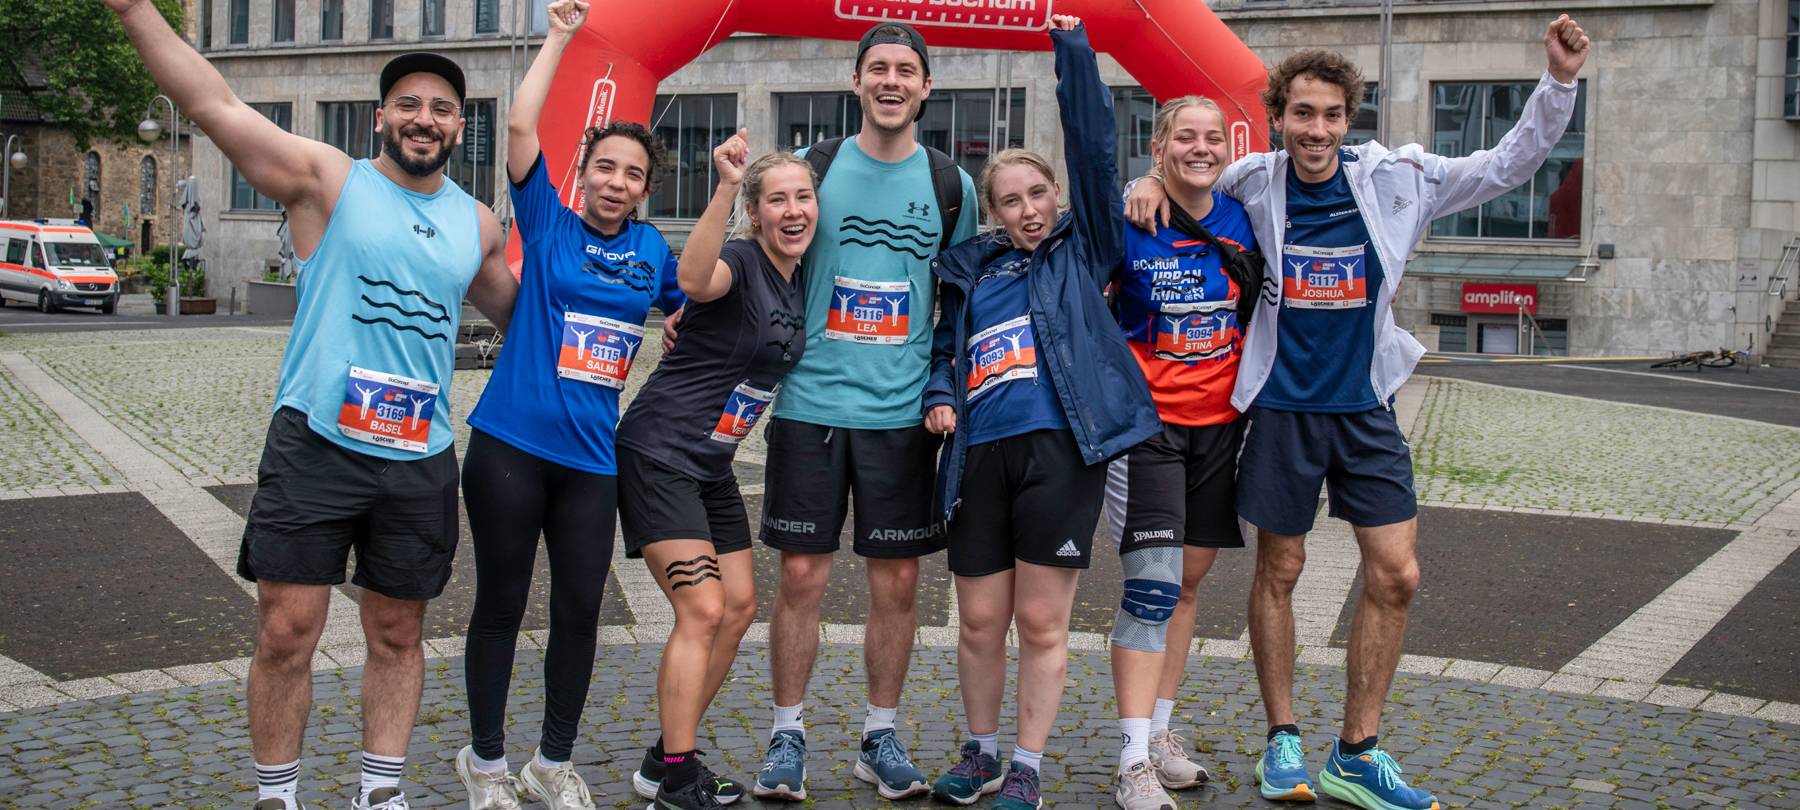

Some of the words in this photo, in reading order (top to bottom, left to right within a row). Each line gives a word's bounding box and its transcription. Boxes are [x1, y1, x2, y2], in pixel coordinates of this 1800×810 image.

[928, 0, 1036, 10] ocum
[1309, 275, 1338, 286] 3117
[1302, 289, 1345, 298] JOSHUA
[1464, 290, 1534, 308] amplifon
[854, 308, 883, 321] 3116
[857, 323, 878, 333] LEA
[1187, 328, 1213, 340] 3094
[1184, 341, 1213, 351] STINA
[592, 345, 620, 362] 3115
[980, 349, 1004, 368] 3093
[586, 360, 619, 375] SALMA
[986, 363, 1000, 376] LIV
[377, 404, 405, 421] 3169
[370, 420, 403, 436] BASEL
[868, 522, 941, 541] ARMOUR
[1133, 529, 1174, 542] SPALDING
[1056, 549, 1081, 557] adidas
